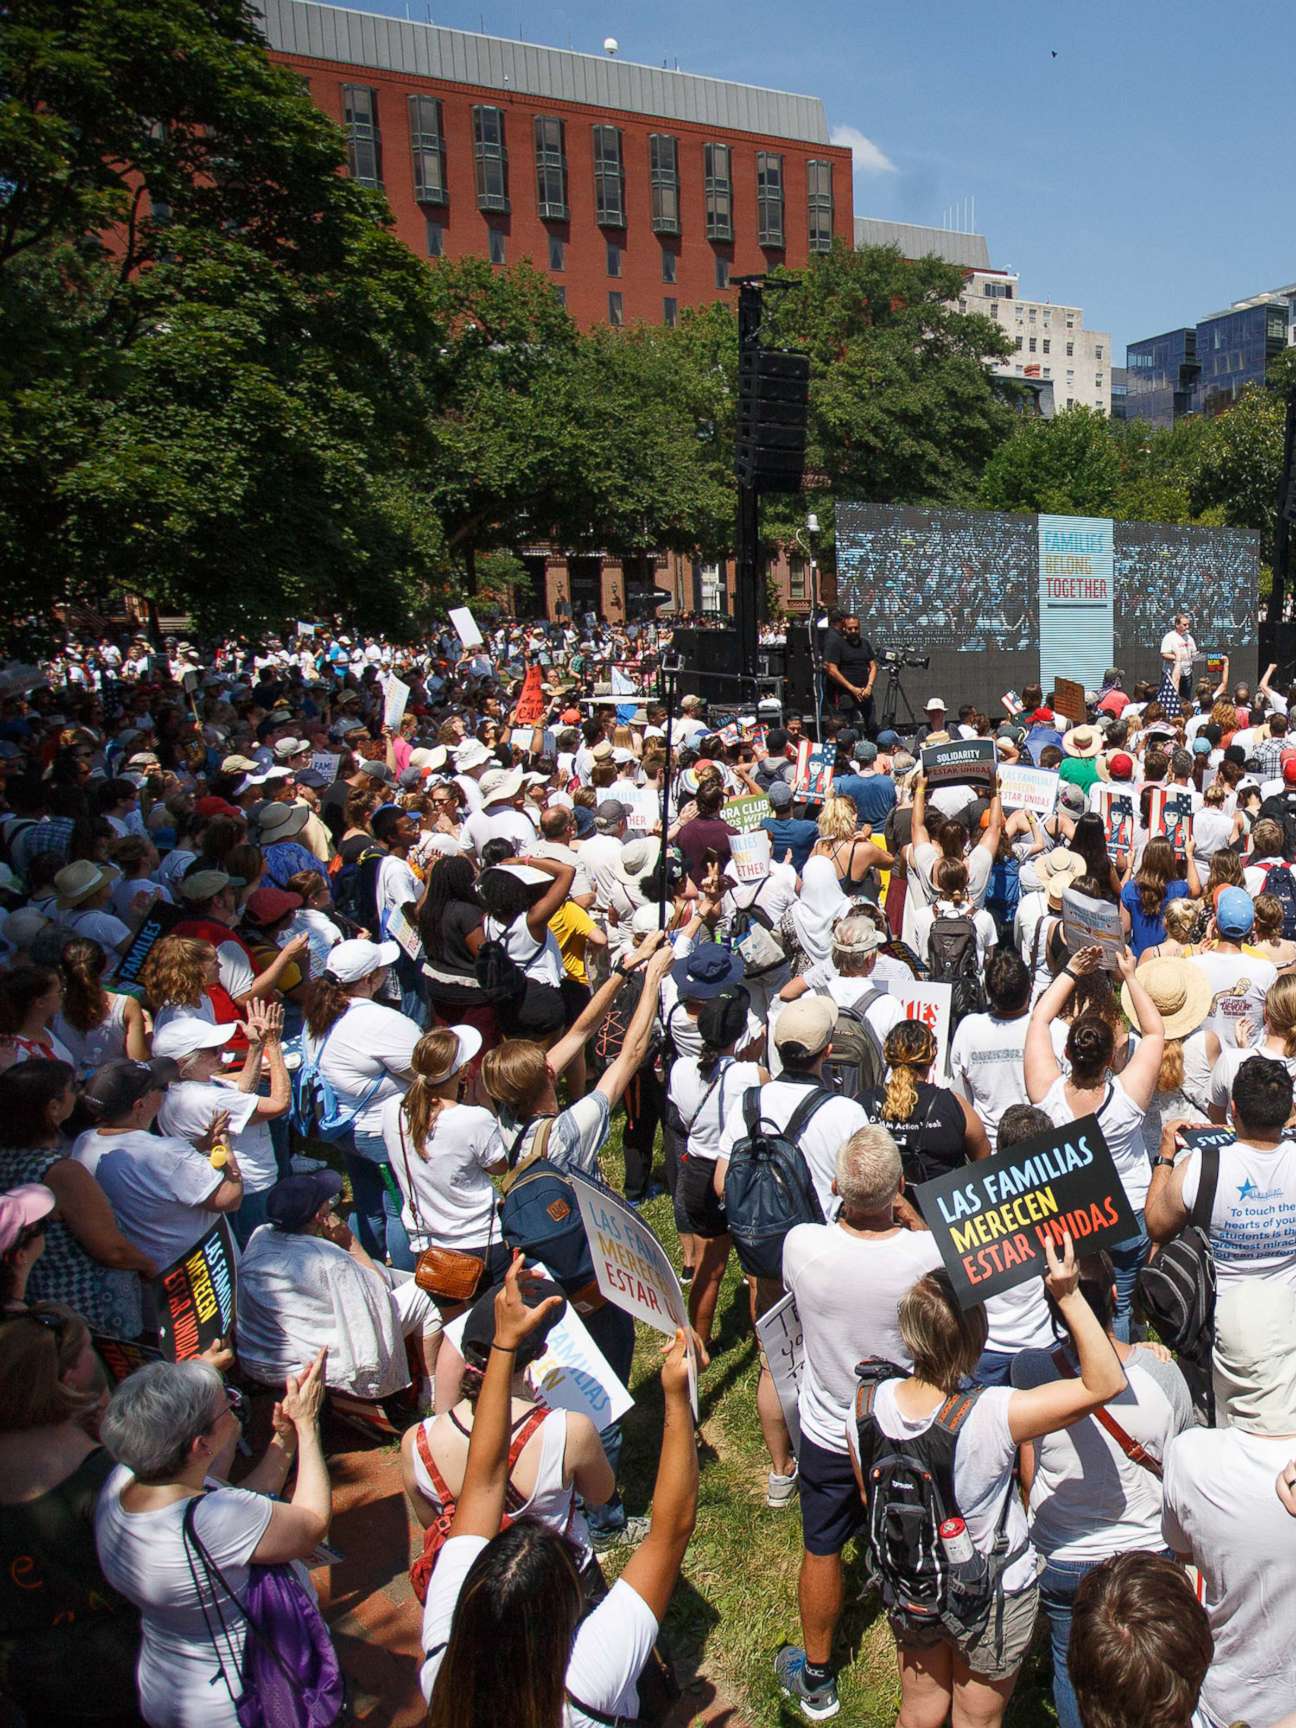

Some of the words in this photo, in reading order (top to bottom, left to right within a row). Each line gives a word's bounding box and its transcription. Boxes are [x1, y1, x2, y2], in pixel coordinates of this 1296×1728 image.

[1046, 577, 1107, 598] TOGETHER
[936, 749, 980, 763] SOLIDARITY
[742, 799, 768, 815] CLUB
[121, 920, 161, 979] FAMILIES
[895, 1122, 920, 1131] Action
[937, 1182, 982, 1224] LAS
[982, 1136, 1094, 1204] FAMILIAS
[588, 1201, 622, 1241] LAS
[948, 1186, 1060, 1254] MERECEN
[1224, 1217, 1261, 1231] hearts
[1262, 1217, 1275, 1228] of
[1231, 1208, 1243, 1218] To
[1245, 1203, 1276, 1217] touch
[1278, 1202, 1296, 1214] the
[204, 1231, 224, 1267] LAS
[961, 1233, 1036, 1286] ESTAR
[1034, 1196, 1120, 1250] UNIDAS
[1218, 1229, 1271, 1242] students
[1272, 1227, 1282, 1239] is
[163, 1267, 192, 1319] ESTAR
[185, 1249, 219, 1325] MERECEN
[604, 1261, 663, 1315] ESTAR
